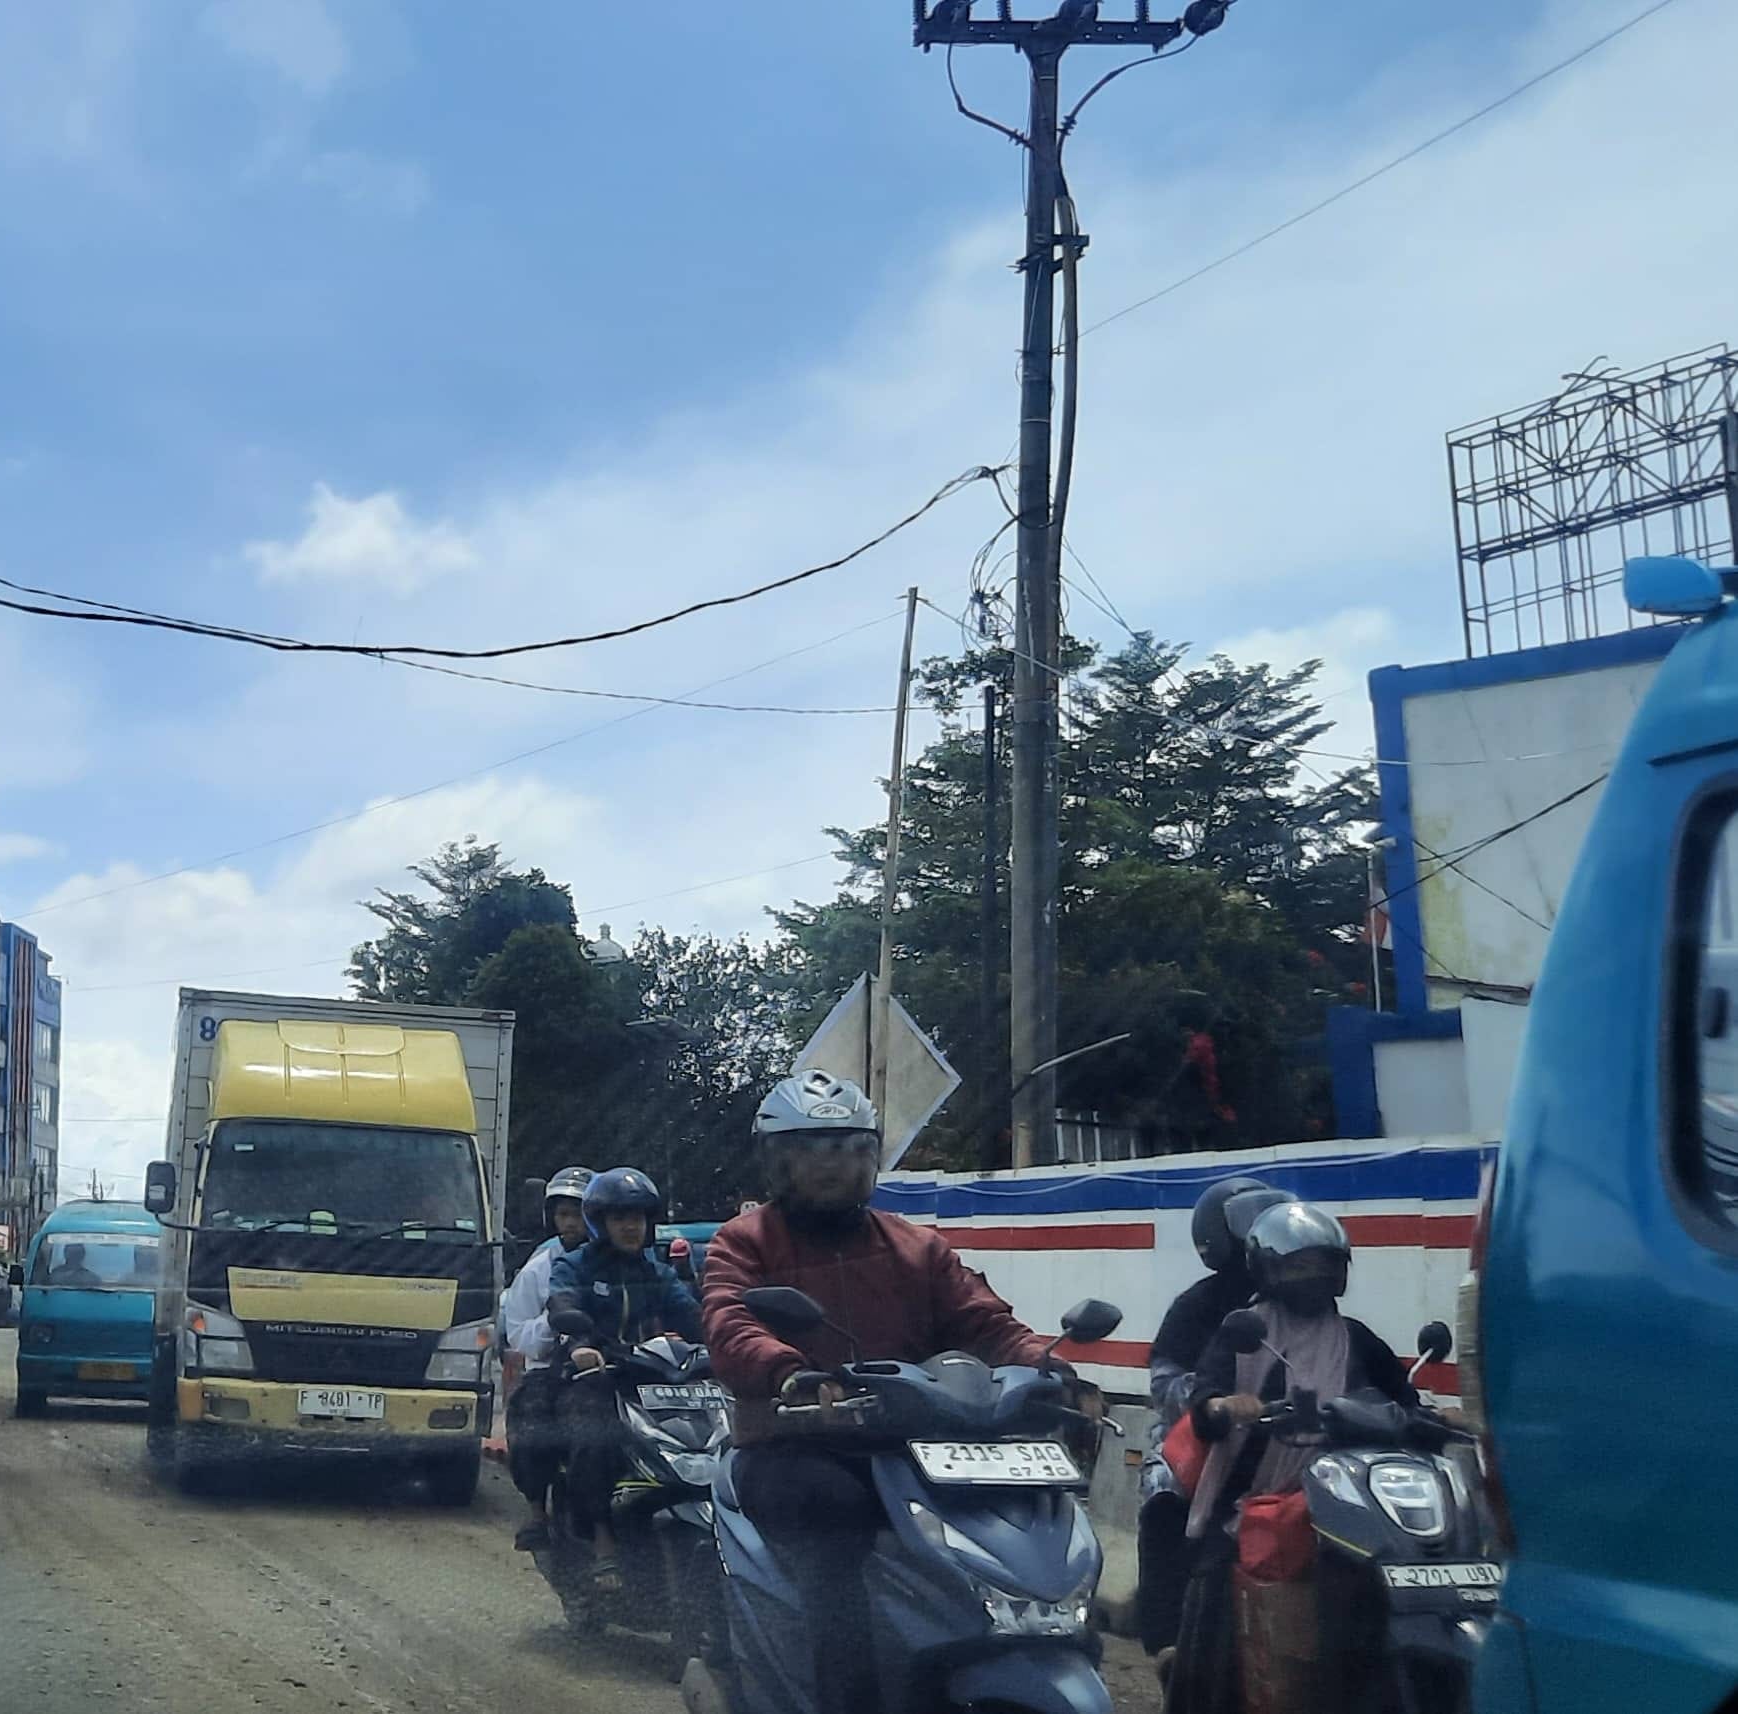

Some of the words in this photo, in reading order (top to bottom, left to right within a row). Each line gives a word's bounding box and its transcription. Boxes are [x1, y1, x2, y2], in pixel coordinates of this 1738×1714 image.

[266, 1324, 363, 1337] MITSUBISHI
[301, 1391, 308, 1405] F
[944, 1446, 1004, 1461] 2115
[1016, 1446, 1063, 1461] SAG
